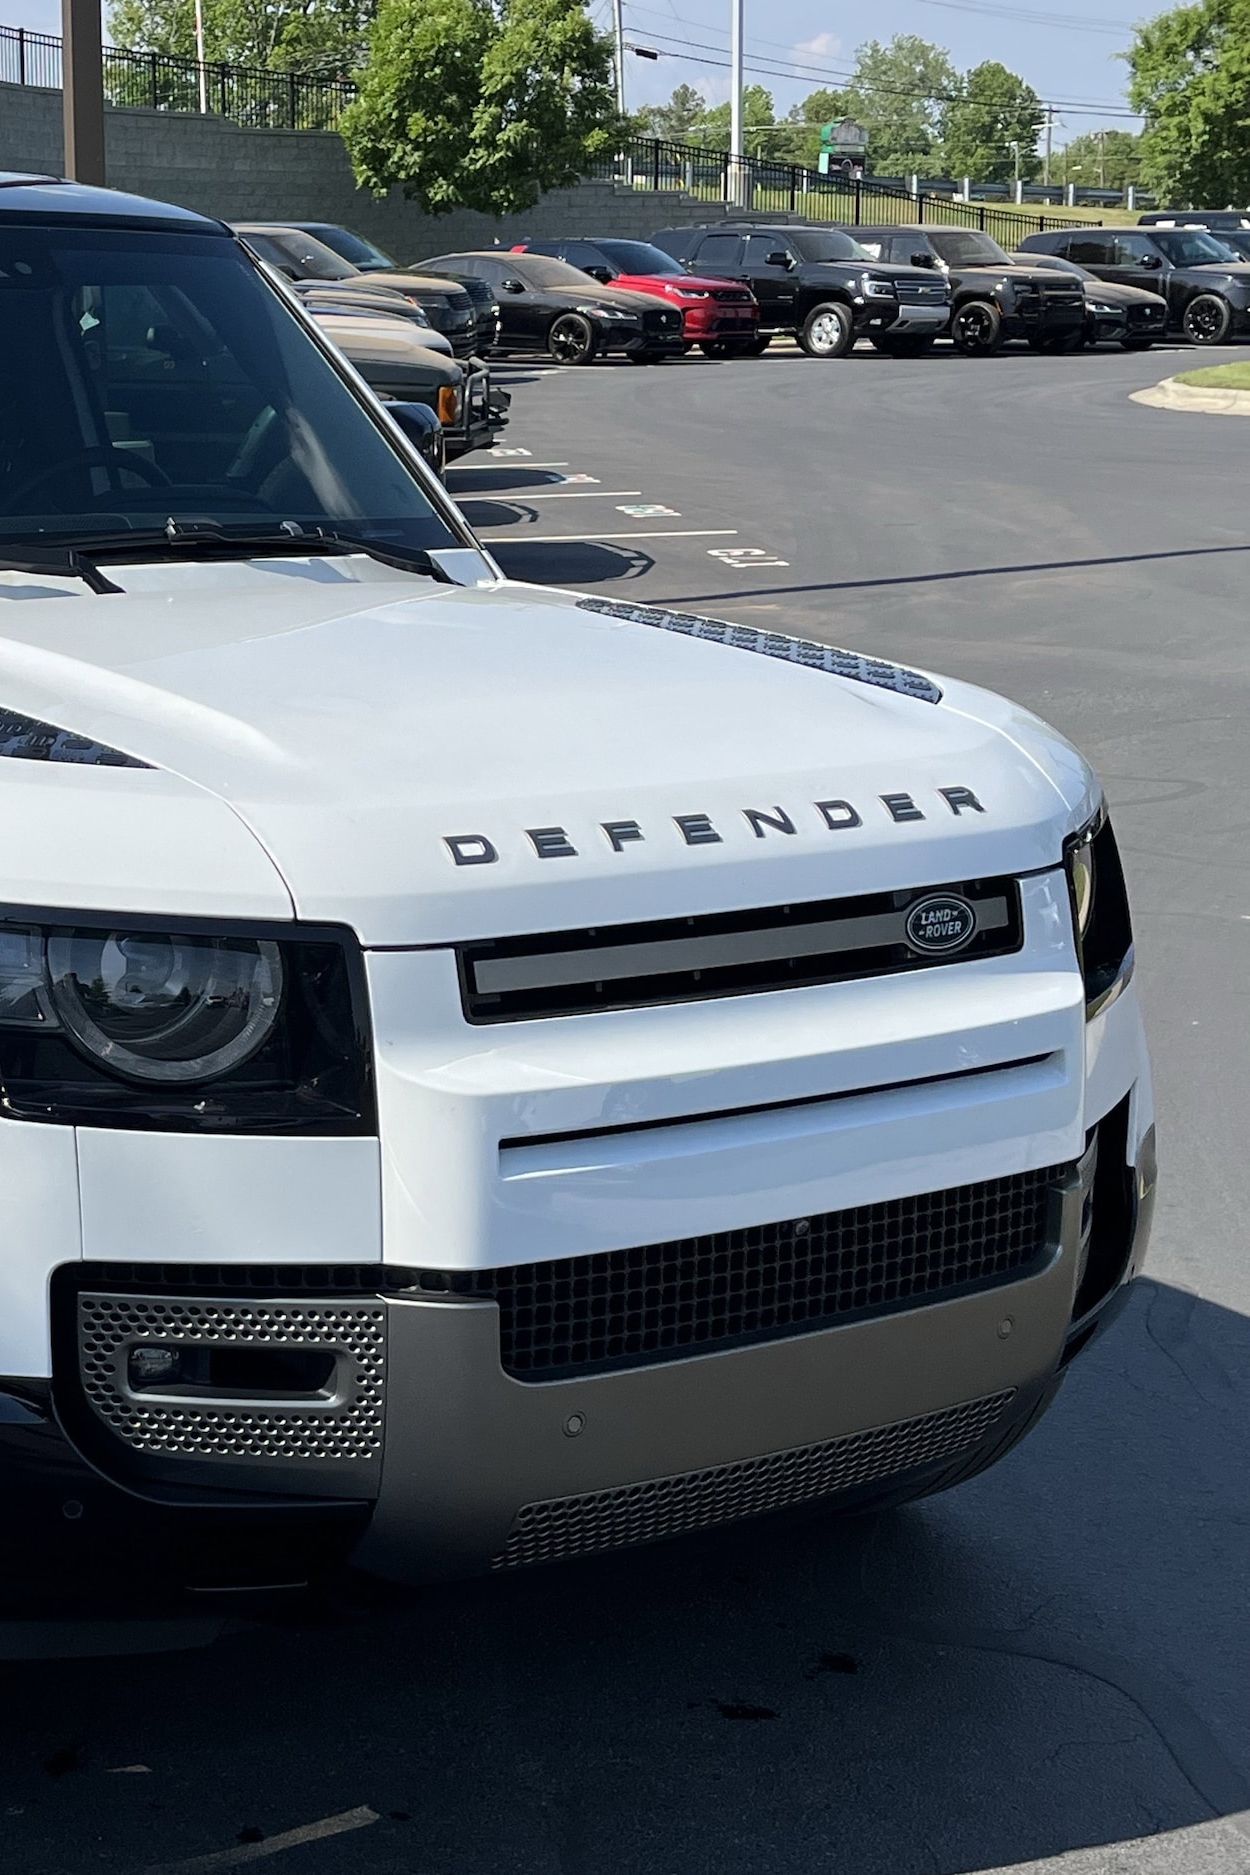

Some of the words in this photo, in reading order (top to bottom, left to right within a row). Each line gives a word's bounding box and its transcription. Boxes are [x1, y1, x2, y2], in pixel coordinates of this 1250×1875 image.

[442, 785, 988, 866] DEFENDER
[921, 909, 951, 925] LAND
[925, 921, 962, 938] ROVER
